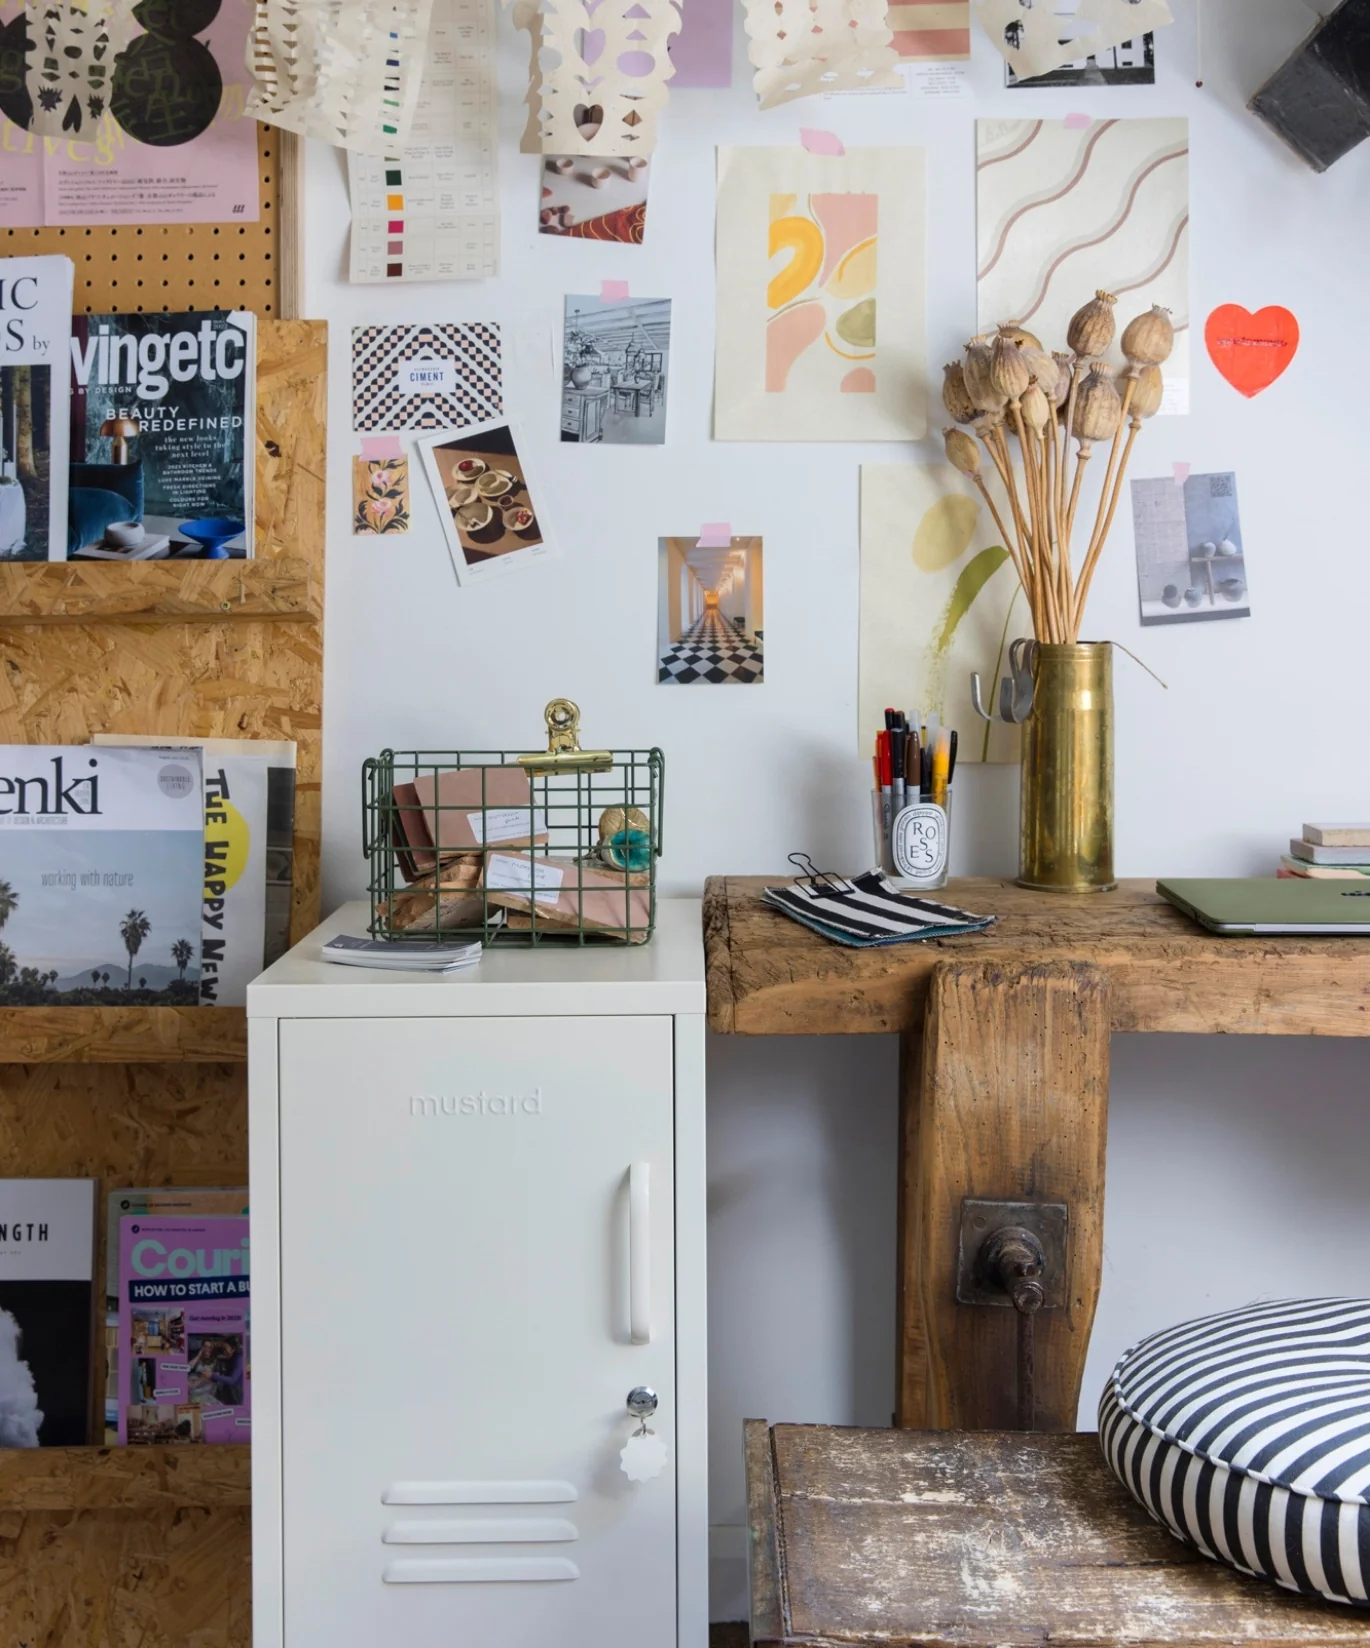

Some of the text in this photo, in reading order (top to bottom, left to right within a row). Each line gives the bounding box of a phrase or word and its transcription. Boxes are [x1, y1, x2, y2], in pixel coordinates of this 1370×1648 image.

[33, 335, 50, 356] by
[410, 371, 444, 382] CIMENT
[95, 386, 132, 394] DESIGN
[106, 406, 179, 421] BEAUTY
[139, 416, 243, 432] REDEFINED
[155, 444, 180, 452] taking
[182, 443, 202, 451] style
[0, 755, 103, 814] enki
[205, 768, 230, 826] THE
[41, 868, 134, 891] working with nature
[203, 841, 230, 930] HAPPY
[409, 1085, 542, 1116] mustard
[0, 1222, 49, 1241] NGTH
[131, 1237, 250, 1278] Couri
[134, 1285, 168, 1298] HOW
[170, 1283, 187, 1296] TO
[188, 1281, 225, 1295] START
[226, 1281, 236, 1293] A
